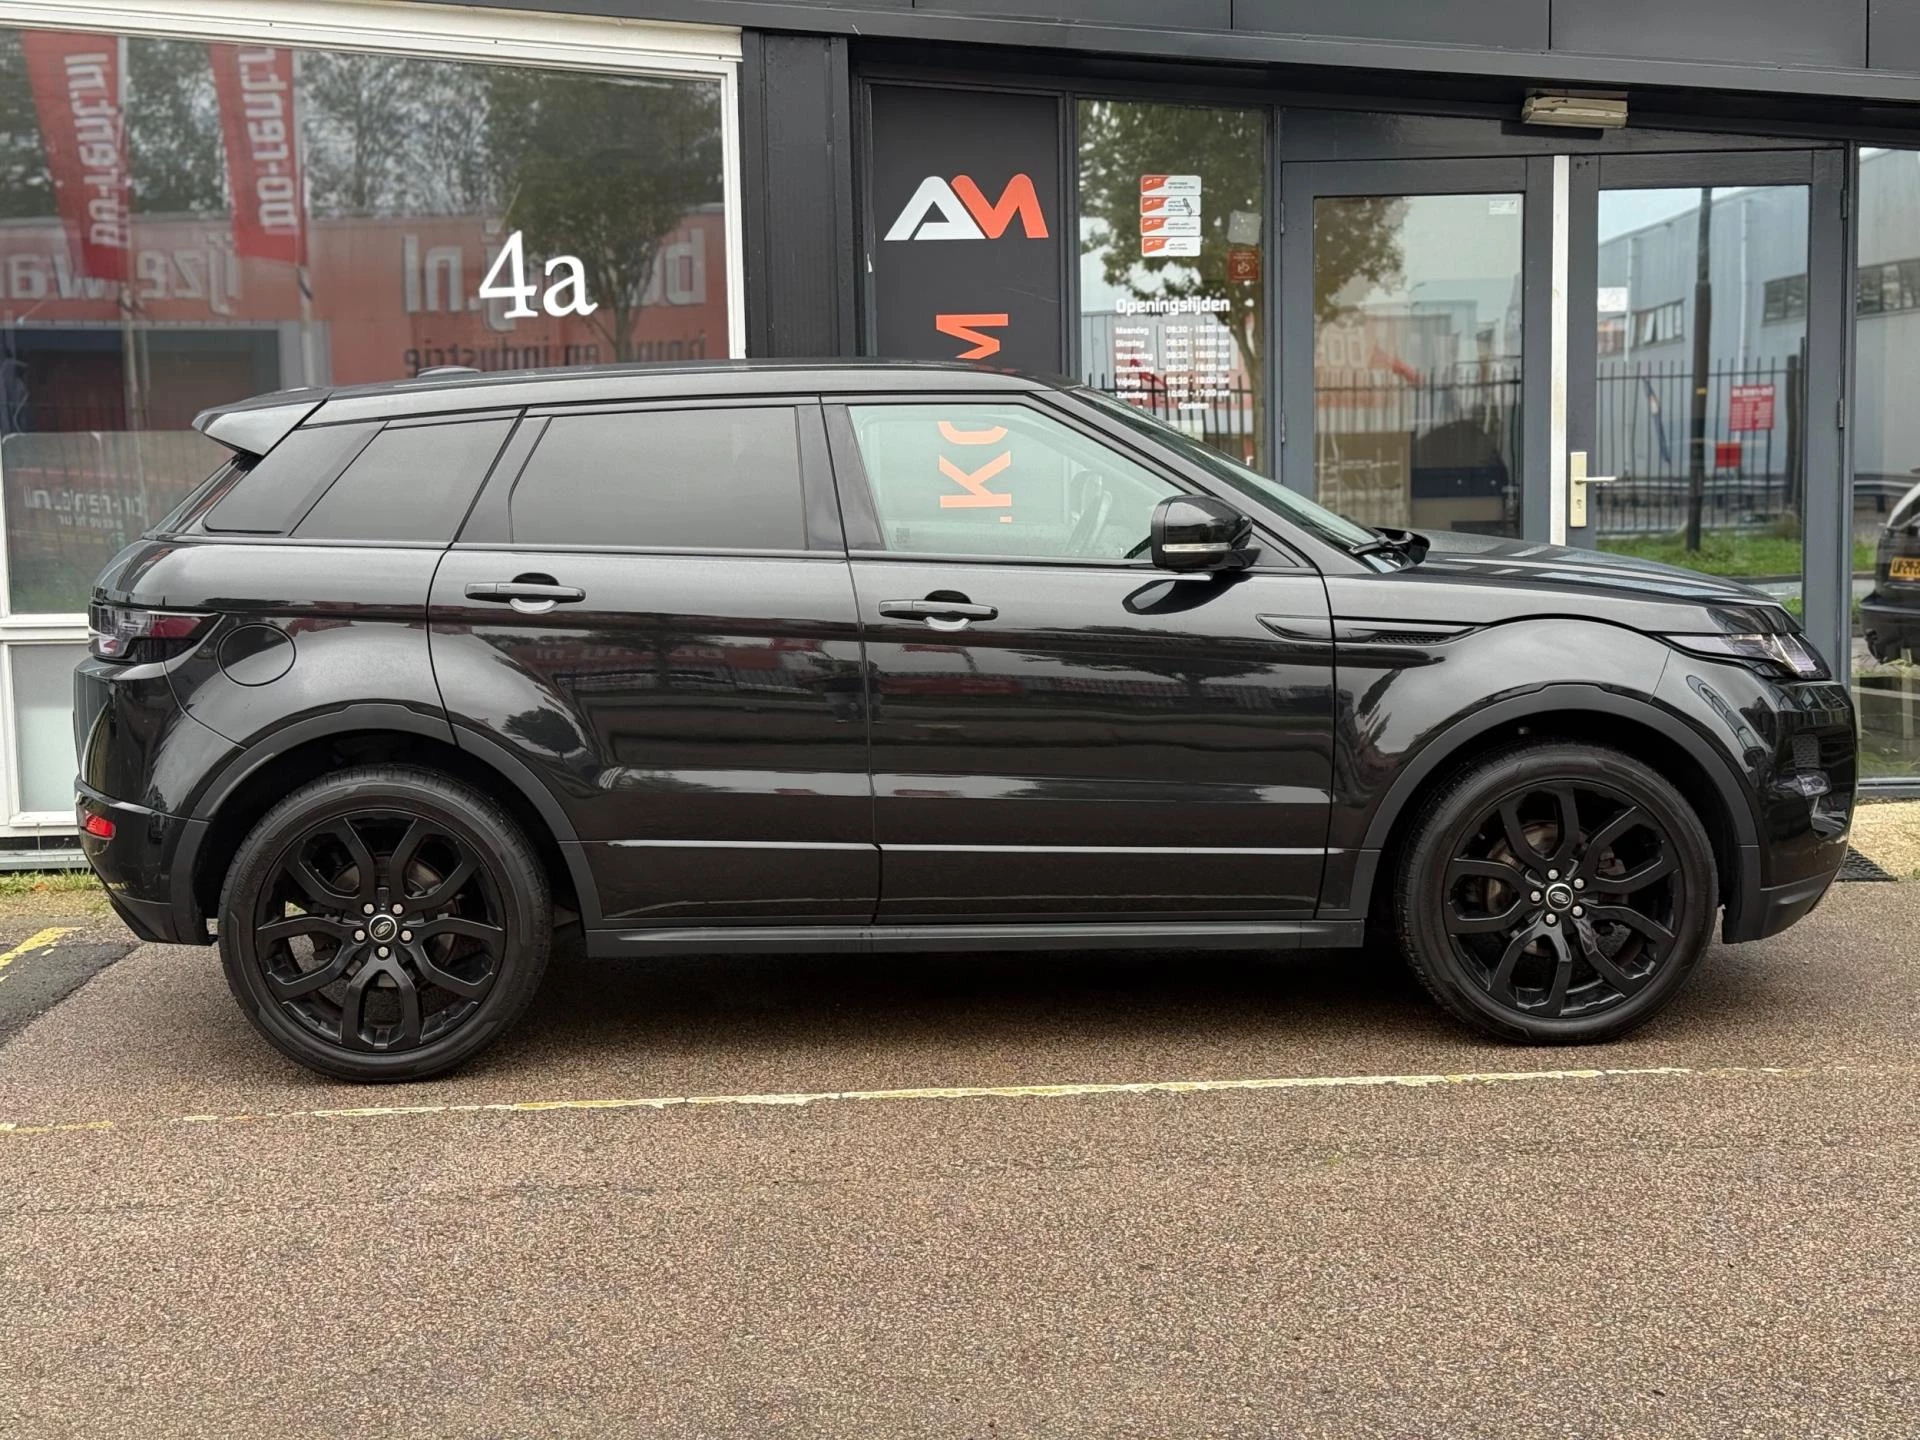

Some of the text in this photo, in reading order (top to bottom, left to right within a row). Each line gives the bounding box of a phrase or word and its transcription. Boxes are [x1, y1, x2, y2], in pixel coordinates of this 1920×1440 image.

[883, 172, 1049, 241] AM
[478, 229, 599, 319] 4a
[1116, 297, 1230, 316] Openingstijden
